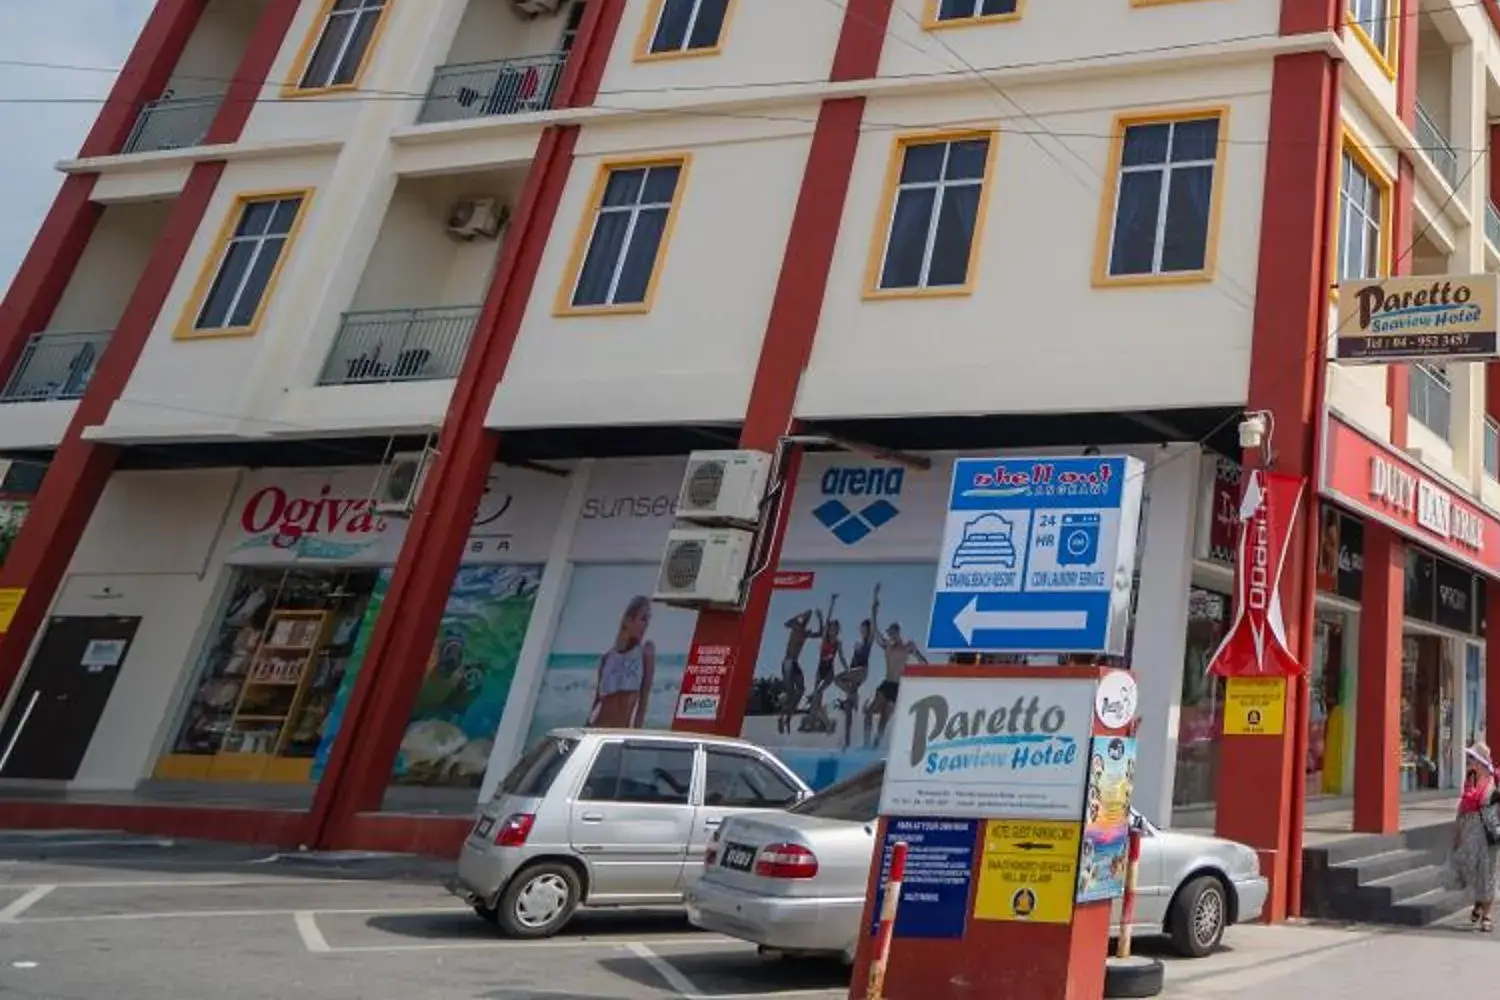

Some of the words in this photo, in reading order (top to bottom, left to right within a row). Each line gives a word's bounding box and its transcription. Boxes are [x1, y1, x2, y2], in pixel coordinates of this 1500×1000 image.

[1354, 281, 1472, 330] Paretto
[1371, 315, 1432, 333] Seaview
[1435, 306, 1482, 328] Hotel
[1393, 336, 1407, 347] 04
[821, 466, 906, 495] arena
[973, 463, 1054, 486] shell
[1059, 463, 1112, 485] out
[1371, 455, 1416, 512] DUTY
[1039, 515, 1056, 527] 24
[1036, 535, 1055, 548] HR
[908, 693, 1066, 767] Paretto
[925, 750, 1008, 774] Seaview
[1011, 743, 1078, 769] Hotel
